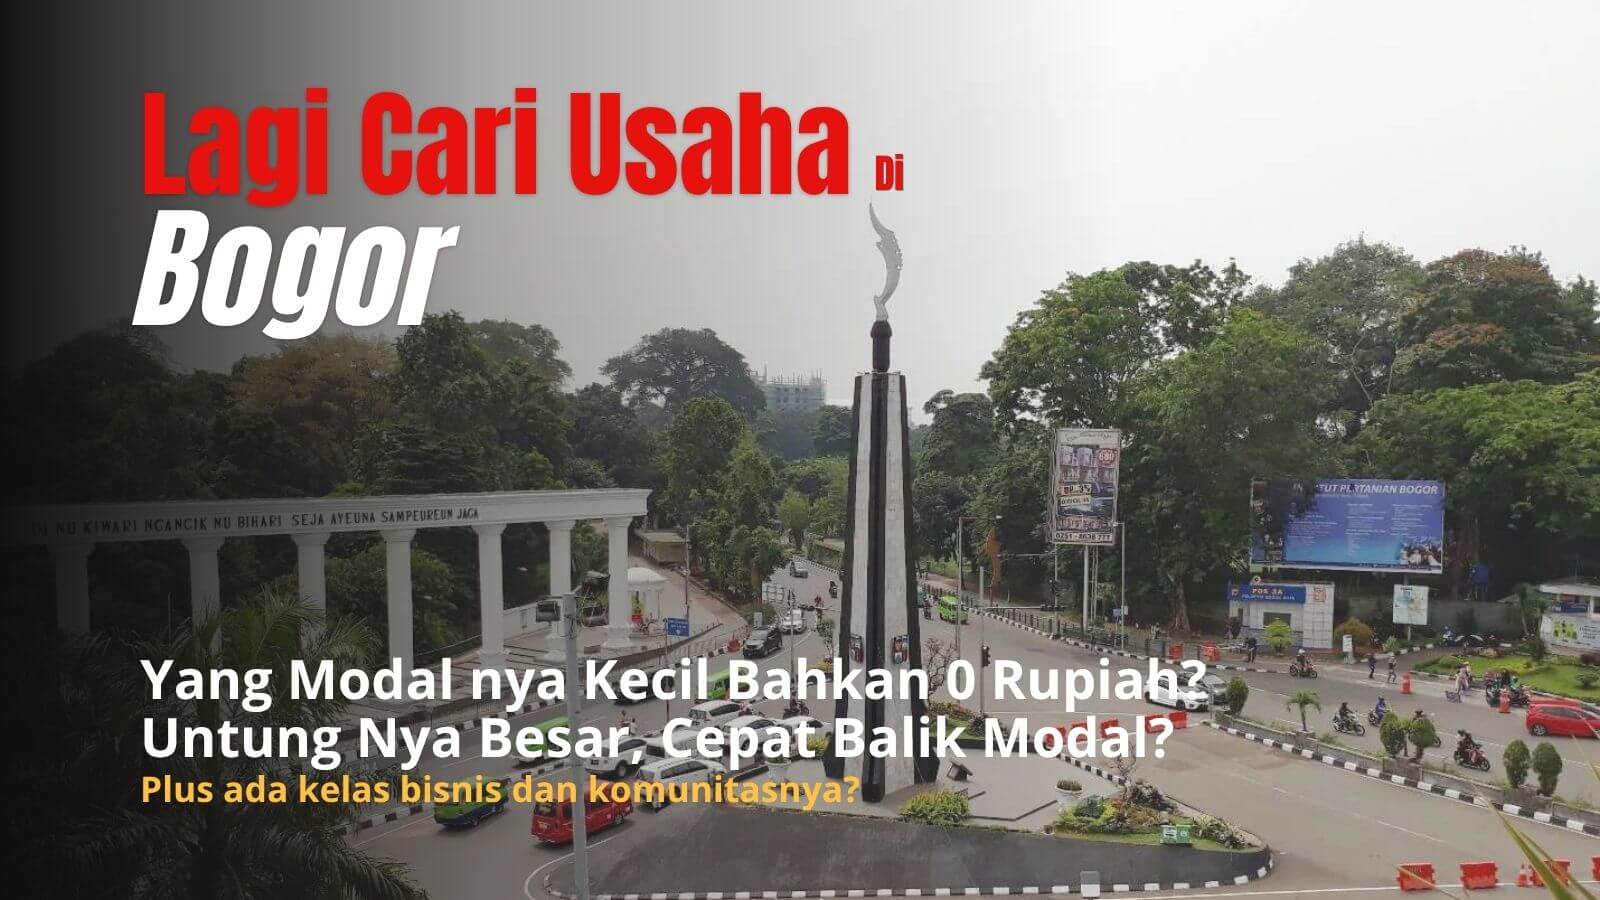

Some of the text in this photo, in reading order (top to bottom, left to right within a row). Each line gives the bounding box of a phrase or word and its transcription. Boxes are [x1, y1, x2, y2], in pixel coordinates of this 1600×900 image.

[1400, 485, 1438, 495] BOGOR
[56, 519, 76, 536] NU
[83, 518, 137, 535] KIWARI
[214, 516, 231, 529] NU
[238, 514, 281, 529] BIHARI
[292, 513, 324, 528] SEJA
[330, 510, 375, 525] AYEUNA
[381, 507, 454, 523] SAMPEUREUN
